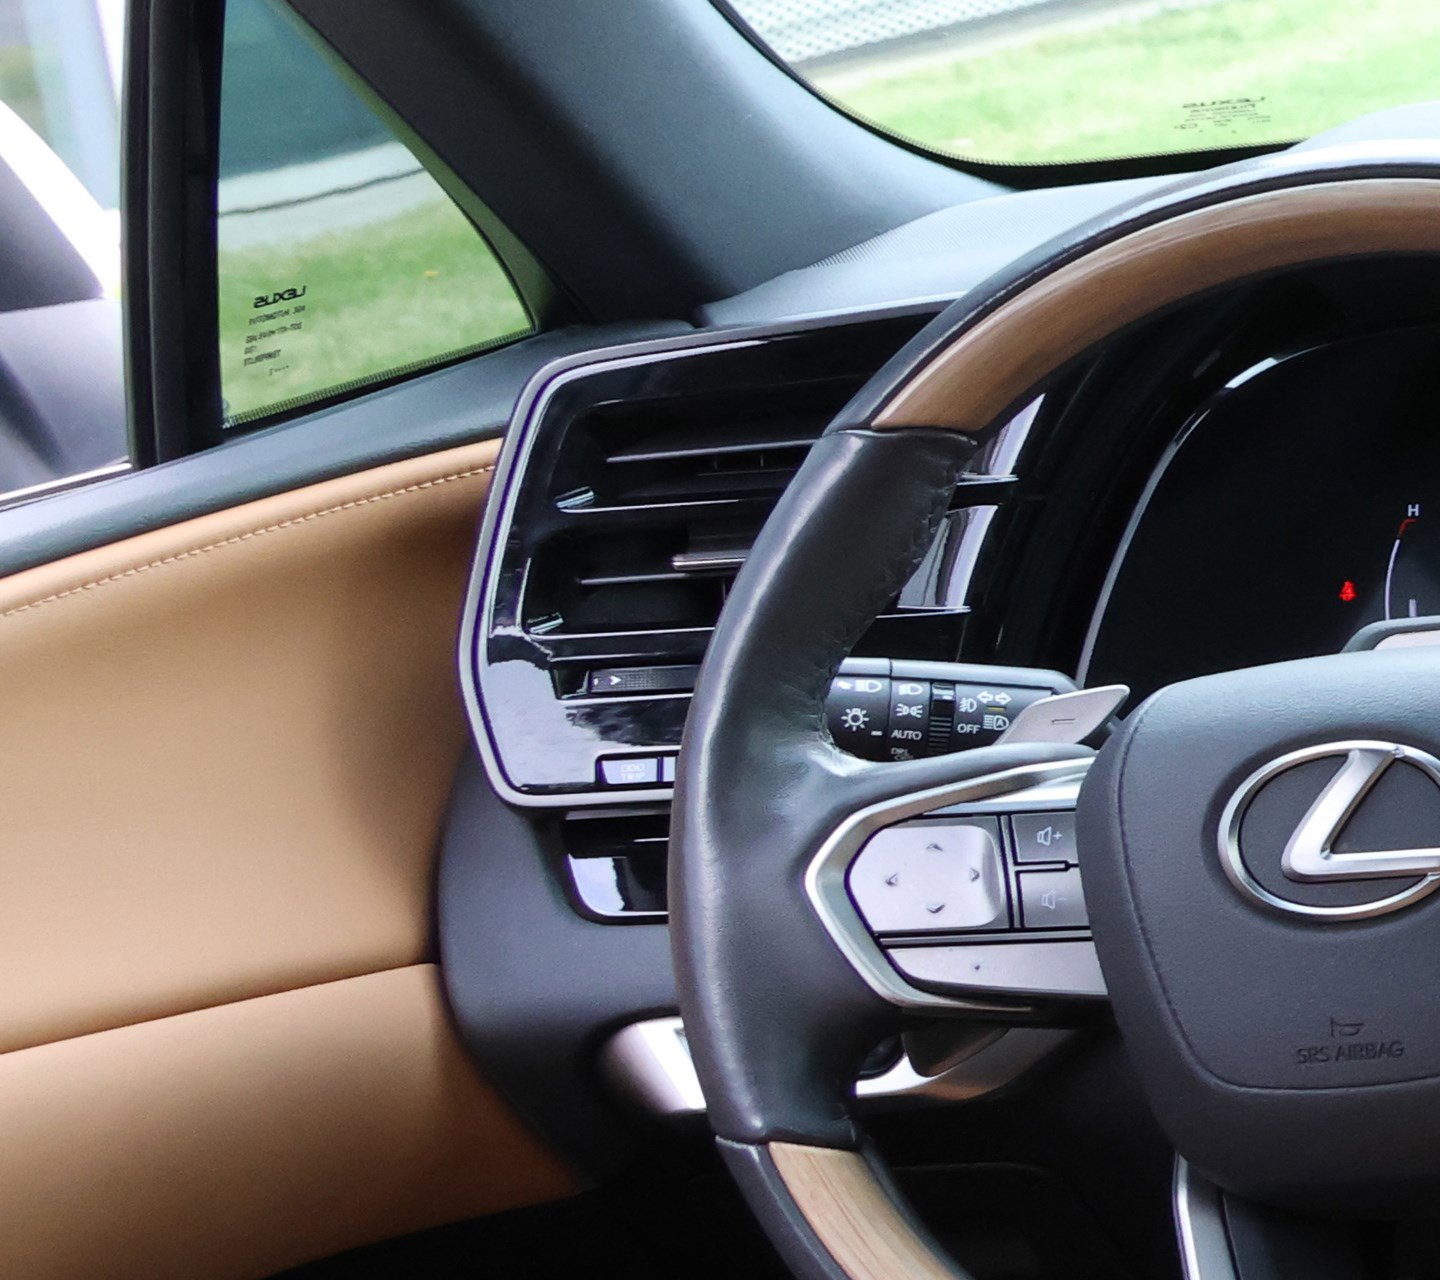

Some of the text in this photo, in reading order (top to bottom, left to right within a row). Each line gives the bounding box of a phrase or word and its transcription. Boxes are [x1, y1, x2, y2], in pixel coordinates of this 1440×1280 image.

[1407, 503, 1420, 517] H
[957, 724, 981, 733] OFF
[891, 730, 922, 739] AUTO
[1296, 1040, 1405, 1064] SRS AIRBAG
